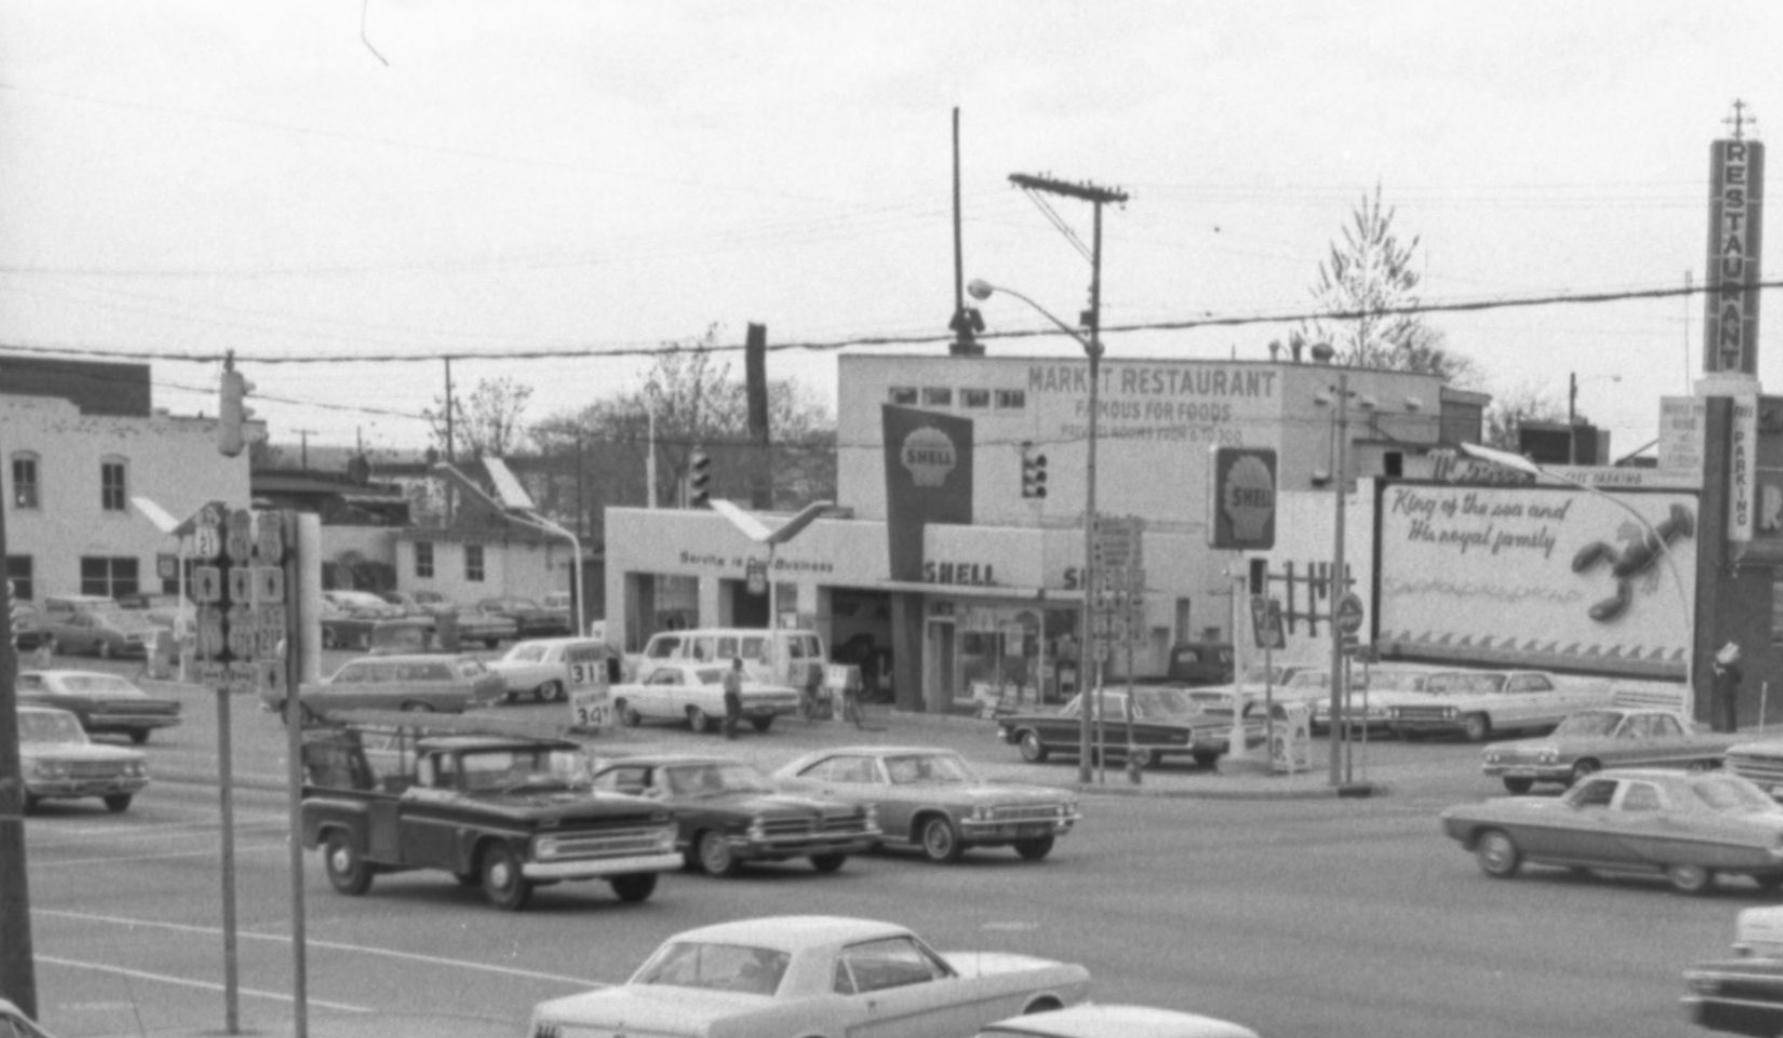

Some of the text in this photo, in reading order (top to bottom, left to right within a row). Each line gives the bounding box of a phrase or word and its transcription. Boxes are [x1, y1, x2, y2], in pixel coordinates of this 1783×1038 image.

[1721, 143, 1746, 369] RESTAURANT
[1028, 366, 1277, 398] MARKT RESTAURANT
[1145, 402, 1174, 421] FOR
[1177, 402, 1232, 422] FOODS
[906, 450, 951, 466] SHELL
[1734, 431, 1748, 526] PARKING
[1231, 486, 1274, 509] SHELL
[1392, 489, 1573, 522] King of the sea and
[1439, 523, 1494, 555] royal
[1492, 525, 1557, 559] family
[775, 558, 834, 573] Business
[925, 561, 999, 586] SHELL
